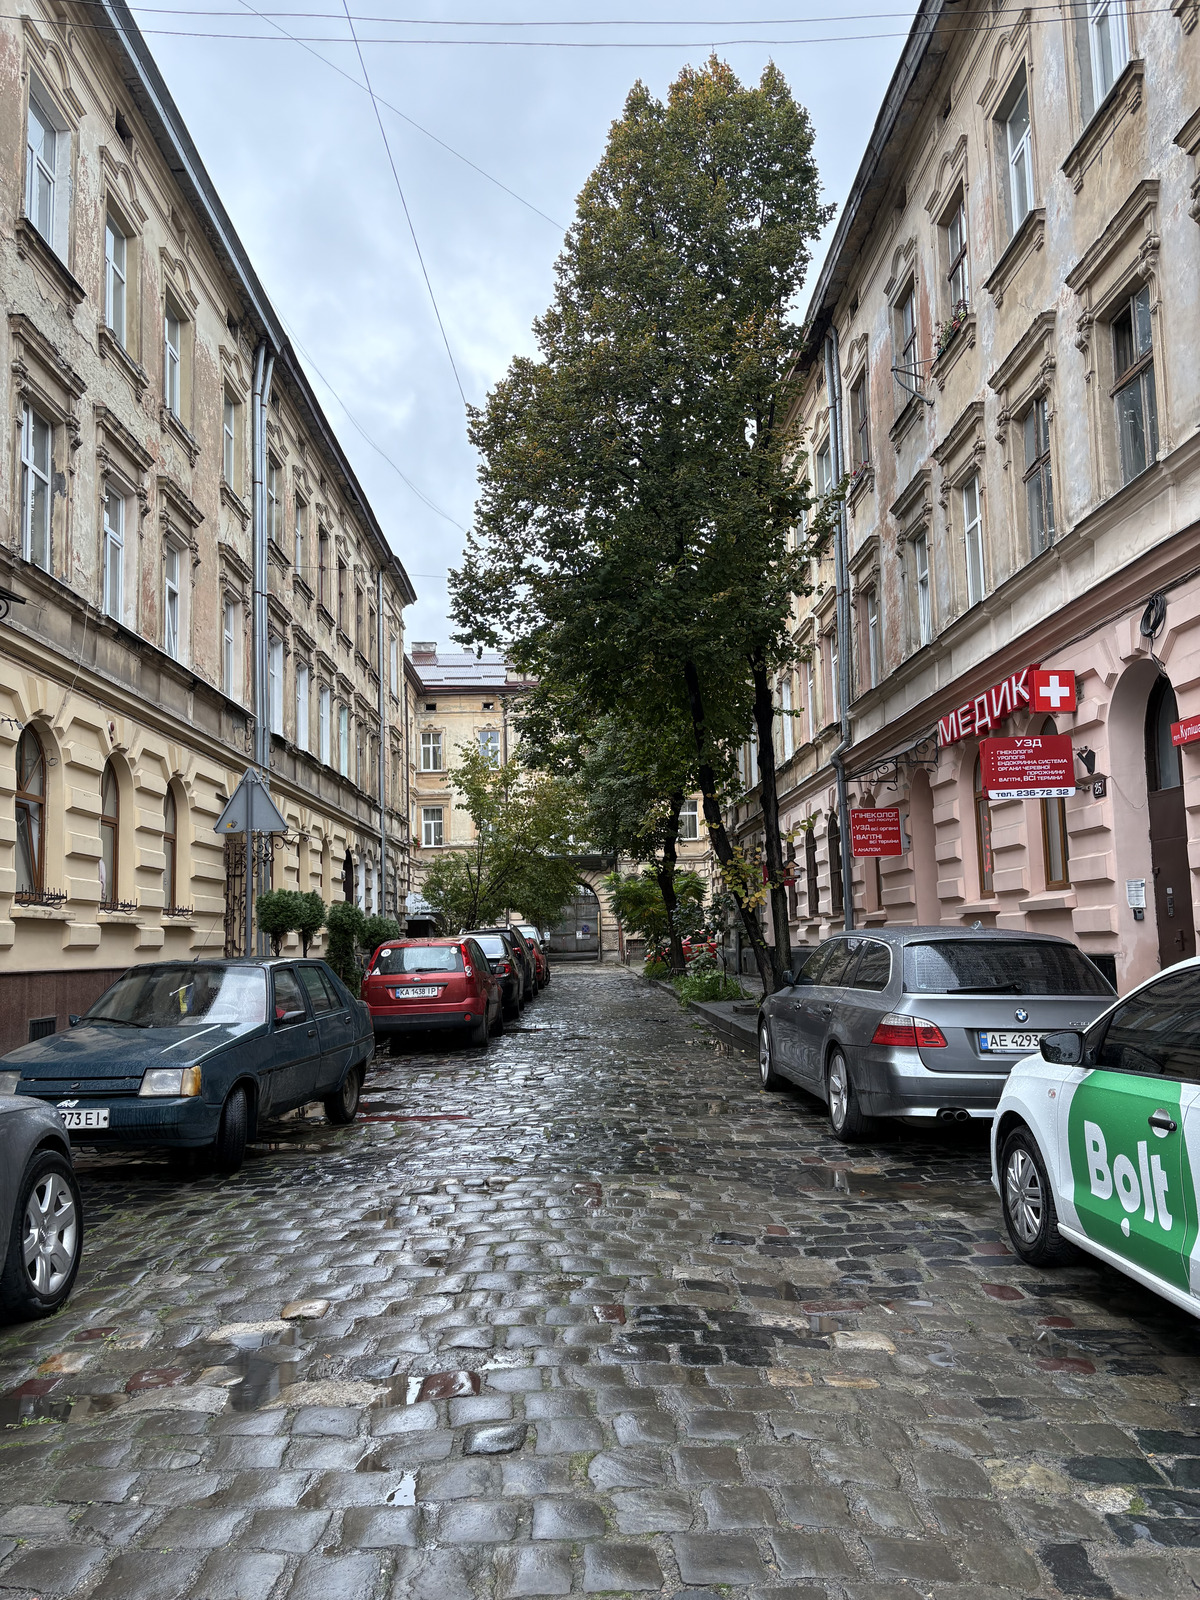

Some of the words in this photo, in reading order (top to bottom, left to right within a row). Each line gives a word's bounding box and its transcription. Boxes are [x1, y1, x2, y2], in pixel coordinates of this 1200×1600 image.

[937, 668, 1030, 747] МЕДИК
[1015, 739, 1042, 748] УЗД
[1016, 789, 1052, 797] 236-72
[1056, 788, 1069, 796] 32
[427, 987, 436, 995] IP
[990, 1034, 1008, 1047] AE
[1010, 1034, 1039, 1047] 4293
[1084, 1119, 1173, 1237] Bolt
